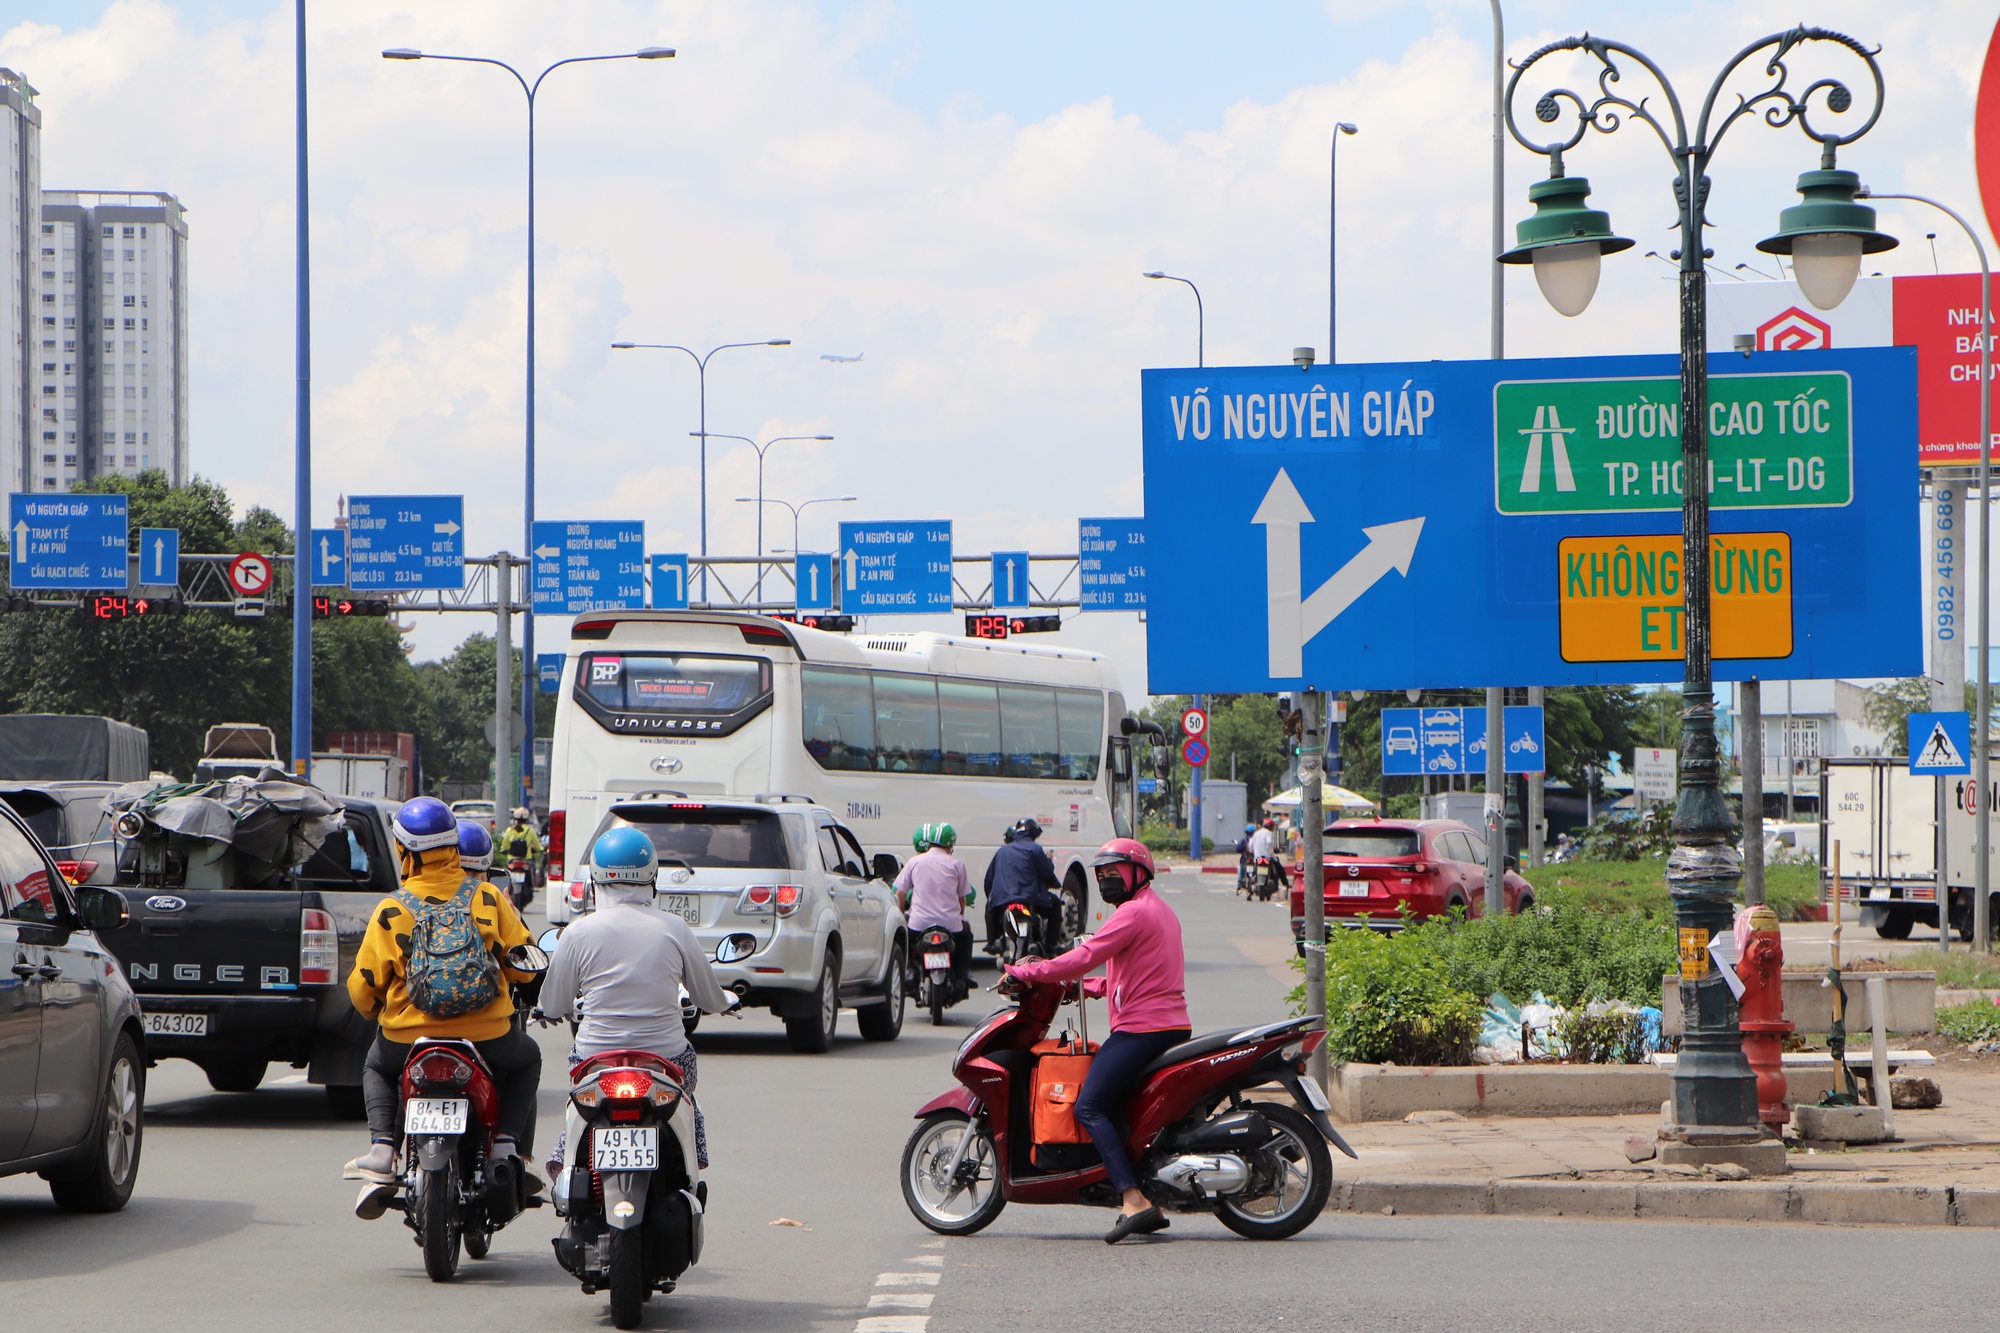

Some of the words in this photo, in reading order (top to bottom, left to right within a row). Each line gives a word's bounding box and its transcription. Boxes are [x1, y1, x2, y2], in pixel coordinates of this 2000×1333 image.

[1170, 386, 1211, 440] VÕ
[1224, 384, 1350, 440] NGUYÊN
[1363, 380, 1435, 436] GIÁP
[1596, 396, 1678, 439] ĐƯỜN
[1709, 401, 1764, 436] CAO
[1773, 387, 1830, 434] TỐC
[1602, 462, 1640, 496] TP.
[1652, 456, 1826, 494] HC-LT-DG
[26, 504, 36, 516] VÕ
[38, 503, 68, 516] NGUYÊN
[71, 503, 88, 516] GIÁP
[102, 505, 112, 516] 1,6
[114, 505, 125, 516] km
[398, 511, 409, 522] 3,2
[410, 511, 421, 522] km
[1937, 489, 1953, 530] 686
[32, 528, 51, 541] TRẠM
[53, 528, 58, 539] Y
[619, 532, 629, 542] 0,6
[631, 532, 641, 542] km
[854, 531, 864, 543] VÕ
[866, 531, 895, 543] NGUYÊN
[897, 530, 914, 543] GIÁP
[927, 531, 937, 542] 1,6
[939, 531, 949, 542] km
[1128, 533, 1138, 544] 3,2
[1140, 533, 1145, 543] k
[38, 543, 49, 553] AN
[51, 541, 66, 553] PHÚ
[102, 536, 112, 547] 1,8
[114, 536, 125, 546] km
[398, 544, 409, 556] 4,5
[410, 544, 422, 555] km
[860, 556, 879, 568] TRẠM
[882, 556, 886, 566] Y
[1937, 537, 1953, 578] 456
[68, 562, 89, 578] CHIẾC
[101, 567, 112, 578] 2,4
[114, 567, 125, 578] km
[619, 563, 630, 573] 2,5
[631, 563, 642, 573] km
[868, 570, 878, 580] AN
[880, 568, 894, 580] PHÚ
[928, 562, 938, 573] 1,8
[939, 562, 950, 572] km
[1128, 566, 1138, 577] 4,5
[1140, 566, 1146, 577] k
[1566, 544, 1680, 598] KHÔNG
[1714, 538, 1782, 595] ỪNG
[378, 571, 384, 582] 51
[395, 571, 410, 582] 23,3
[411, 571, 422, 582] km
[618, 586, 629, 597] 3,6
[630, 586, 641, 596] km
[896, 590, 916, 604] CHIẾC
[928, 593, 938, 604] 2,4
[940, 593, 950, 603] km
[1108, 593, 1114, 603] 51
[1124, 593, 1139, 604] 23,3
[1141, 593, 1146, 603] k
[95, 597, 126, 618] 124
[1938, 586, 1954, 640] 0982
[975, 618, 1006, 638] 125
[1641, 606, 1686, 652] ET
[614, 718, 722, 730] UNIVERSE
[1190, 717, 1200, 728] 50
[1844, 792, 1859, 801] 60C
[1838, 803, 1864, 812] 544.29
[154, 899, 176, 909] Ford
[669, 896, 689, 908] 72A
[131, 963, 289, 983] NGER
[1210, 1046, 1258, 1066] VISION
[417, 1101, 457, 1115] 84-E1
[411, 1117, 461, 1131] 644.89
[604, 1130, 646, 1147] 49-K1
[597, 1149, 654, 1168] 735.55
